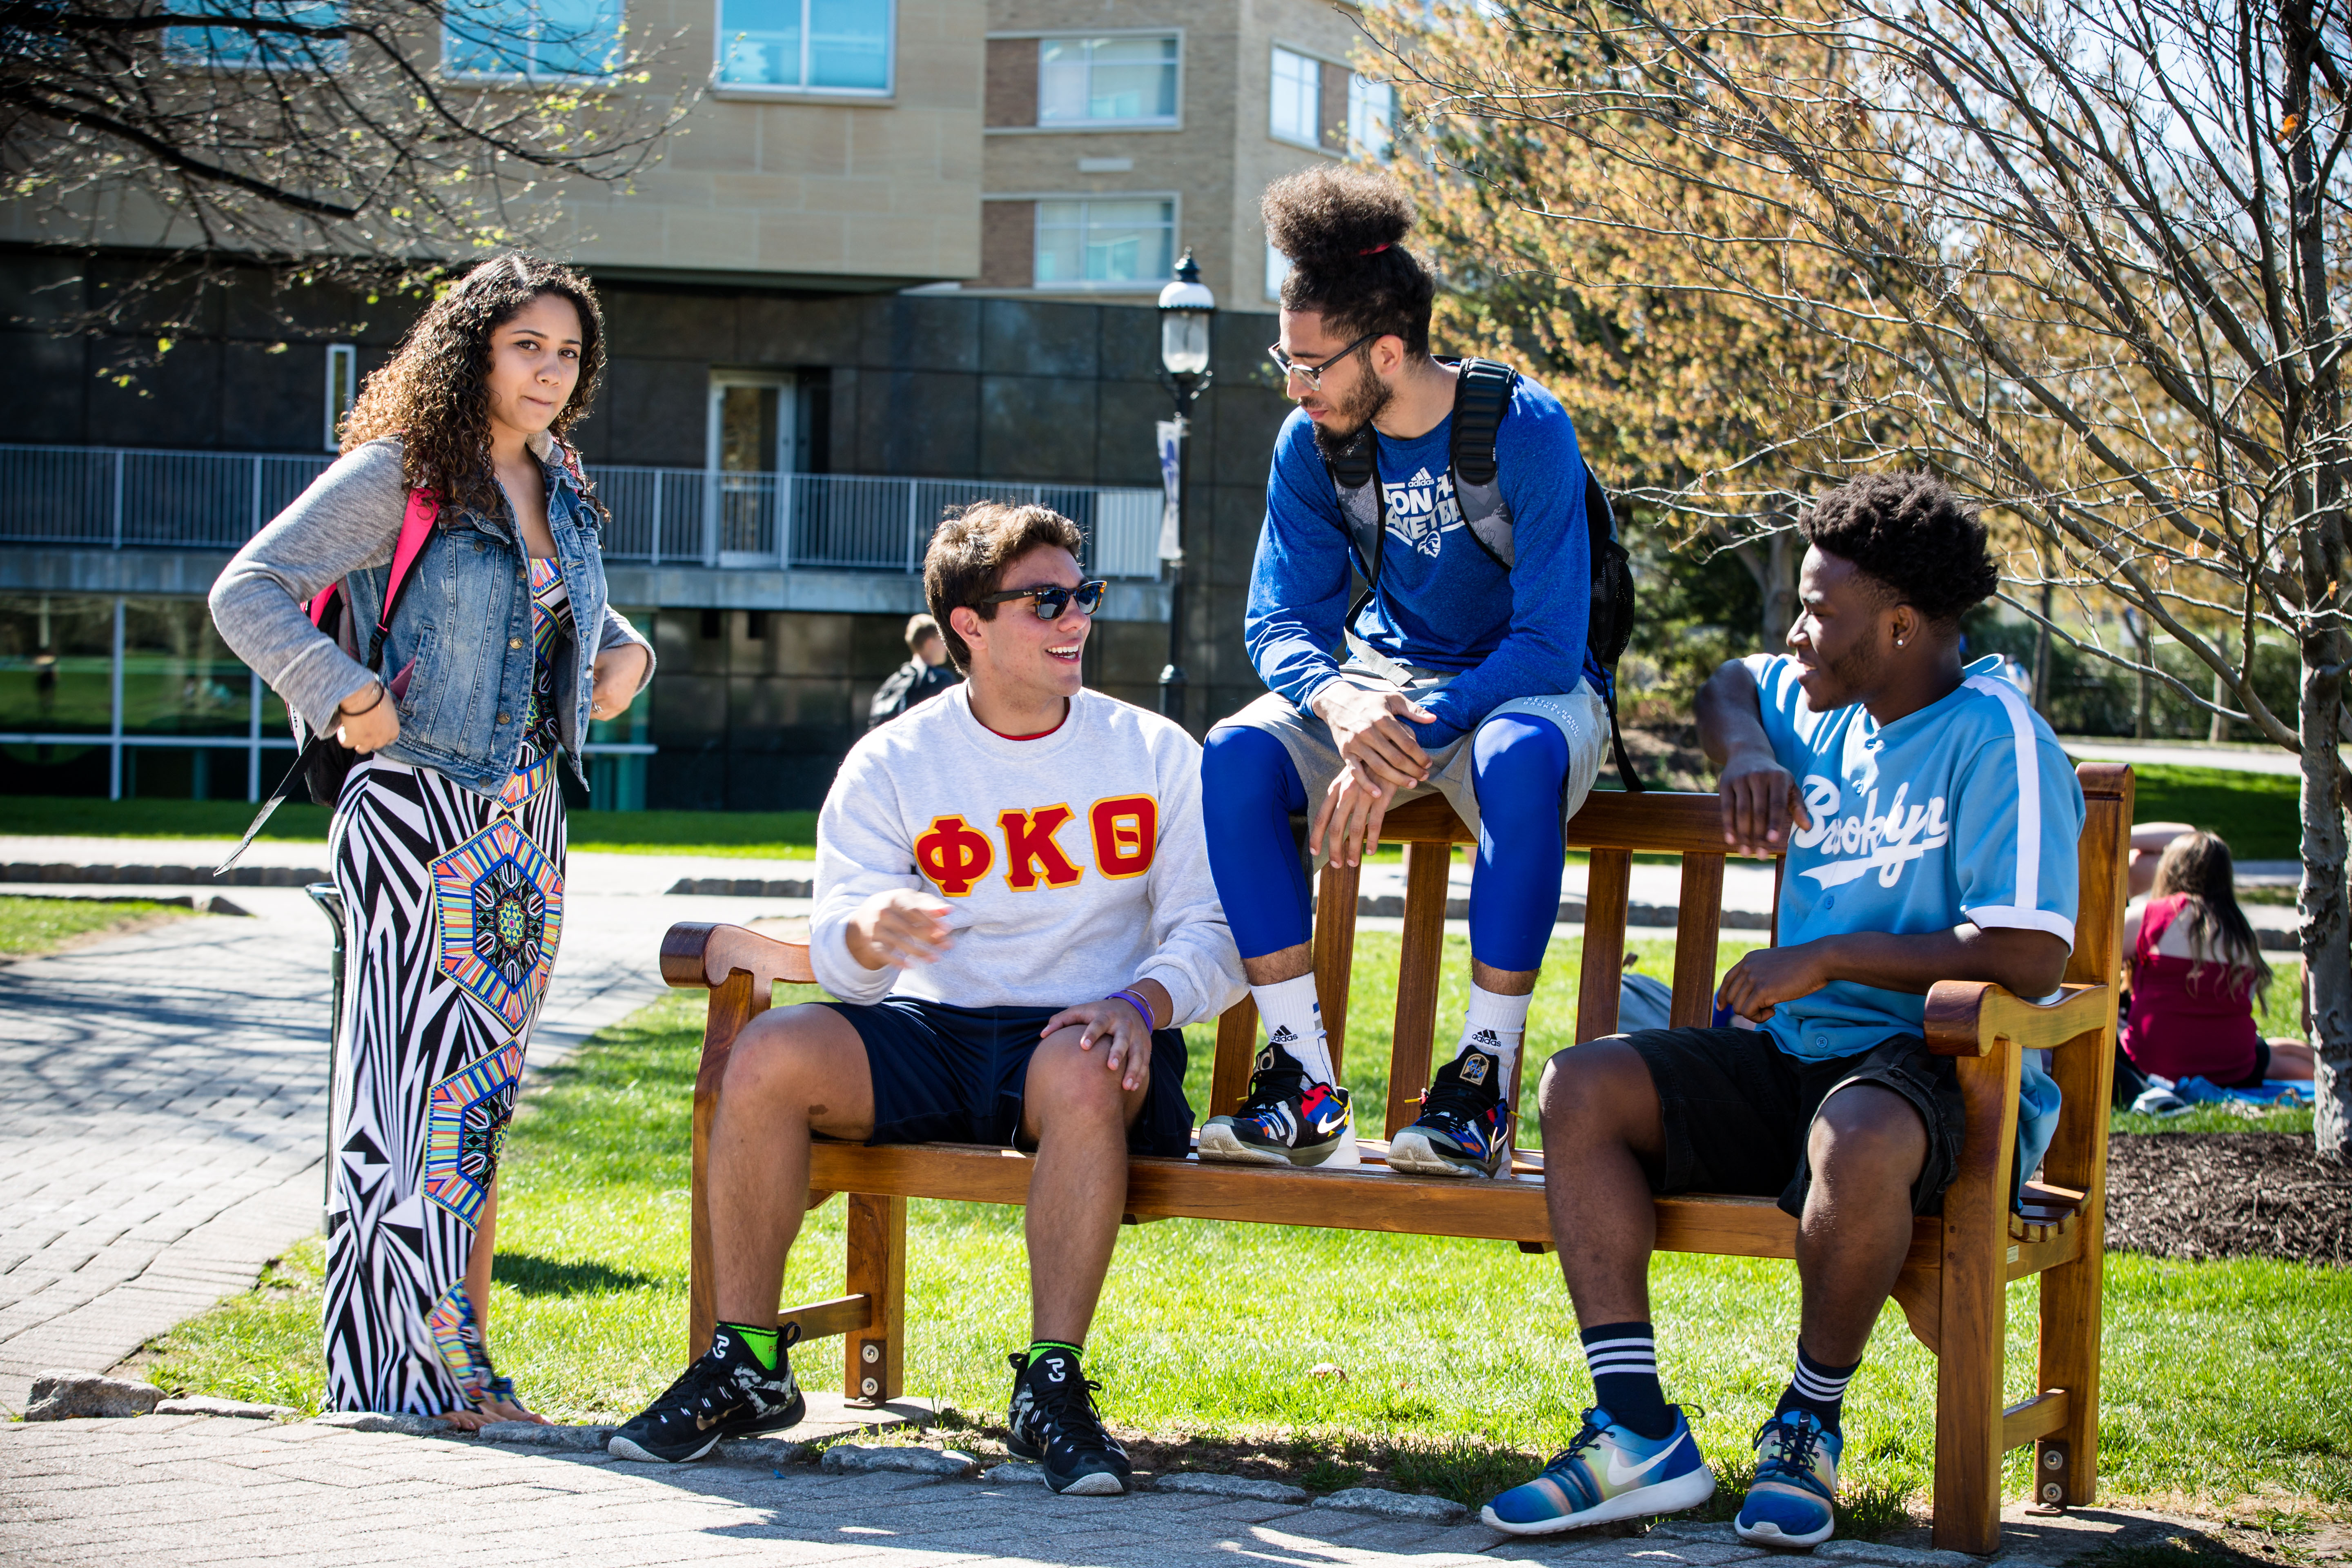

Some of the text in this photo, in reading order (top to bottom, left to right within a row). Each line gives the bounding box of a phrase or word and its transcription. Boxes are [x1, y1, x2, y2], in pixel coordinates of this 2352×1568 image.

[1408, 479, 1434, 488] adidas
[1523, 701, 1577, 737] BASKETBALL
[1526, 697, 1579, 732] SETON HALL
[1271, 1034, 1298, 1042] adidas
[1472, 1034, 1501, 1047] adidas
